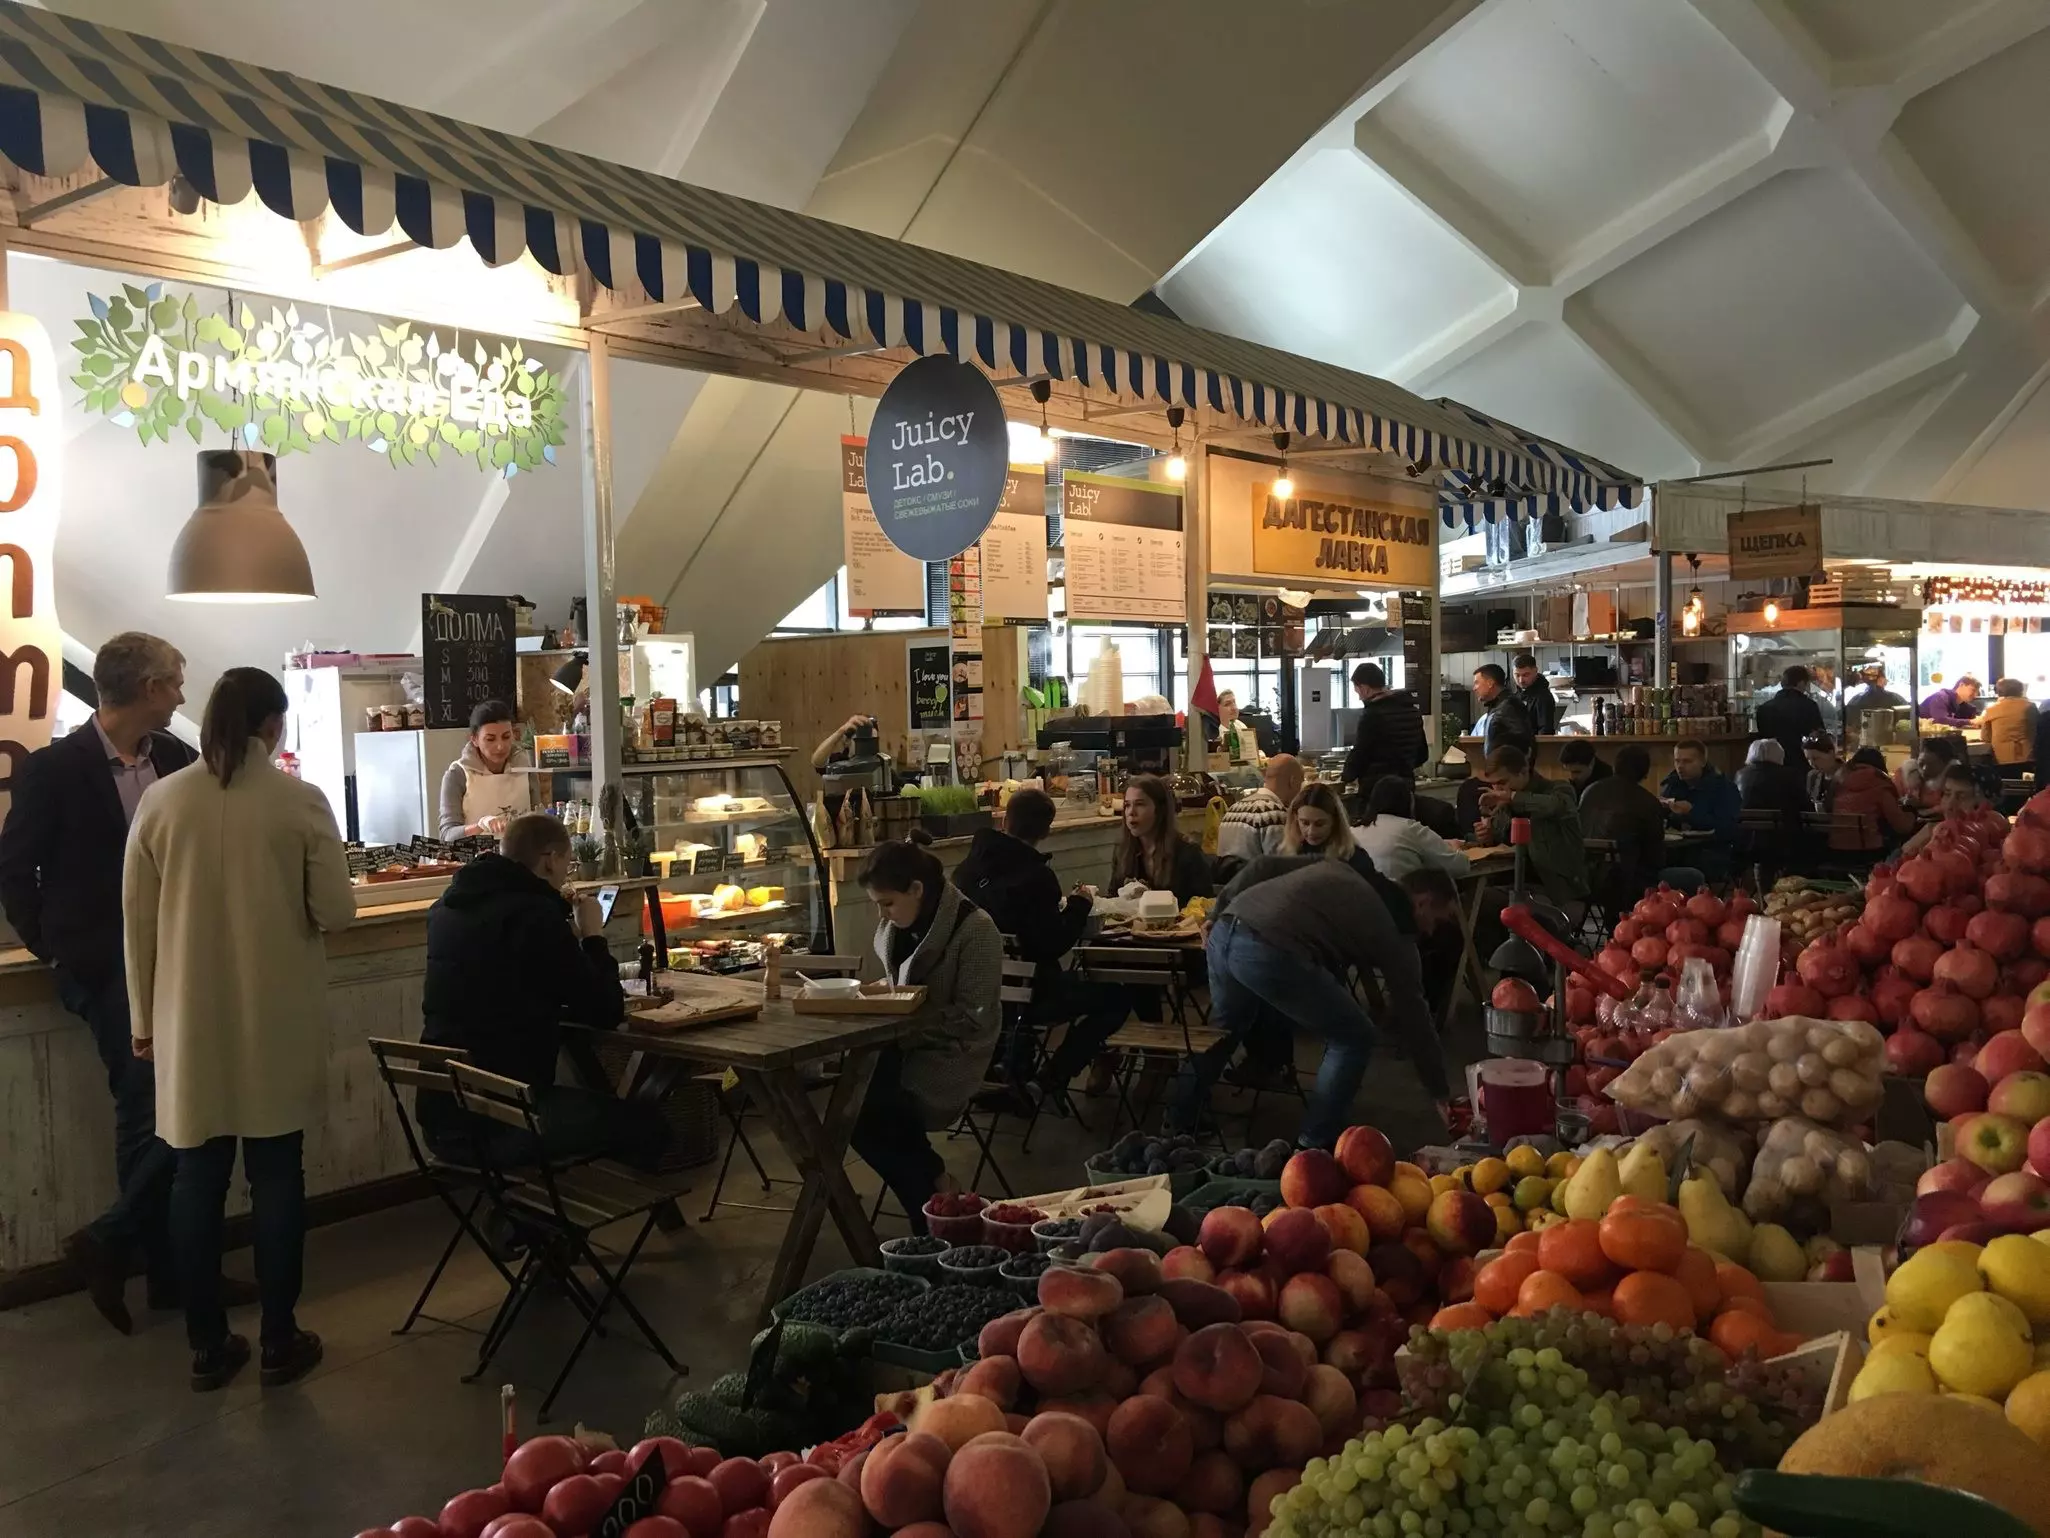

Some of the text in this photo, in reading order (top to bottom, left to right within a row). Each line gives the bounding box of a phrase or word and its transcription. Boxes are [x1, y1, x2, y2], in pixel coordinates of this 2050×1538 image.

[891, 411, 975, 451] Juicy
[892, 453, 955, 491] Lab.
[893, 495, 922, 510] ДЕТОКС
[926, 489, 953, 503] СМУЗИ
[1069, 484, 1101, 504] Juicy
[893, 499, 957, 520] СВЕЖЕВЫЖАТЫЕ
[957, 496, 980, 510] СОКИ
[1262, 493, 1430, 546] ДАГЕСТАНСКАЯ
[1740, 531, 1808, 553] ЩЕПКА
[1315, 537, 1389, 575] ЛАВКА
[434, 612, 506, 642] ДОЛМА
[441, 647, 450, 665] S
[441, 666, 452, 684] M
[913, 667, 949, 685] I love you
[441, 684, 452, 703] L
[441, 704, 458, 722] XL
